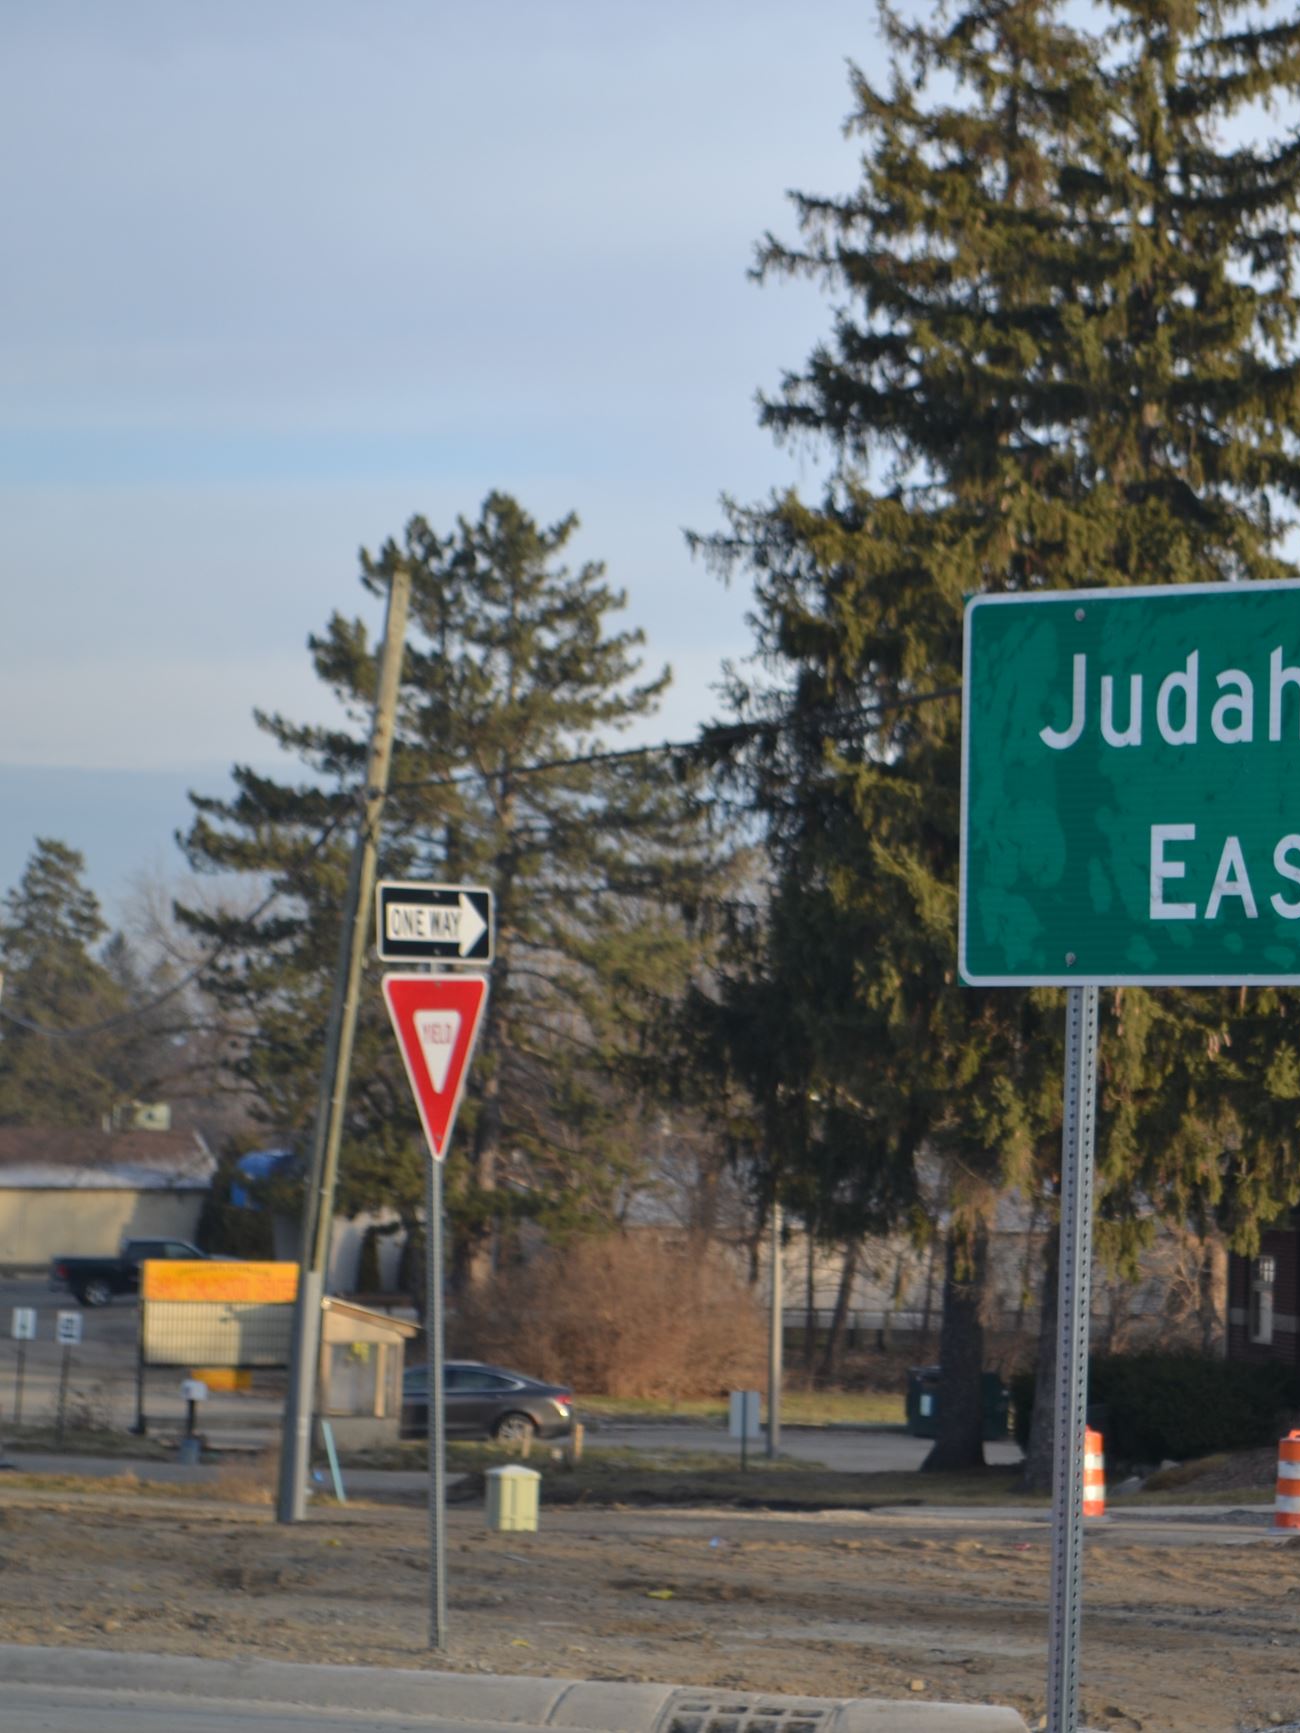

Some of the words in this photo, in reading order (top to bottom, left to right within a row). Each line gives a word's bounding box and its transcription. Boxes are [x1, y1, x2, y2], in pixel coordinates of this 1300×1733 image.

[391, 908, 425, 937] ONE
[428, 910, 461, 938] WAY
[422, 1023, 453, 1045] YIELD
